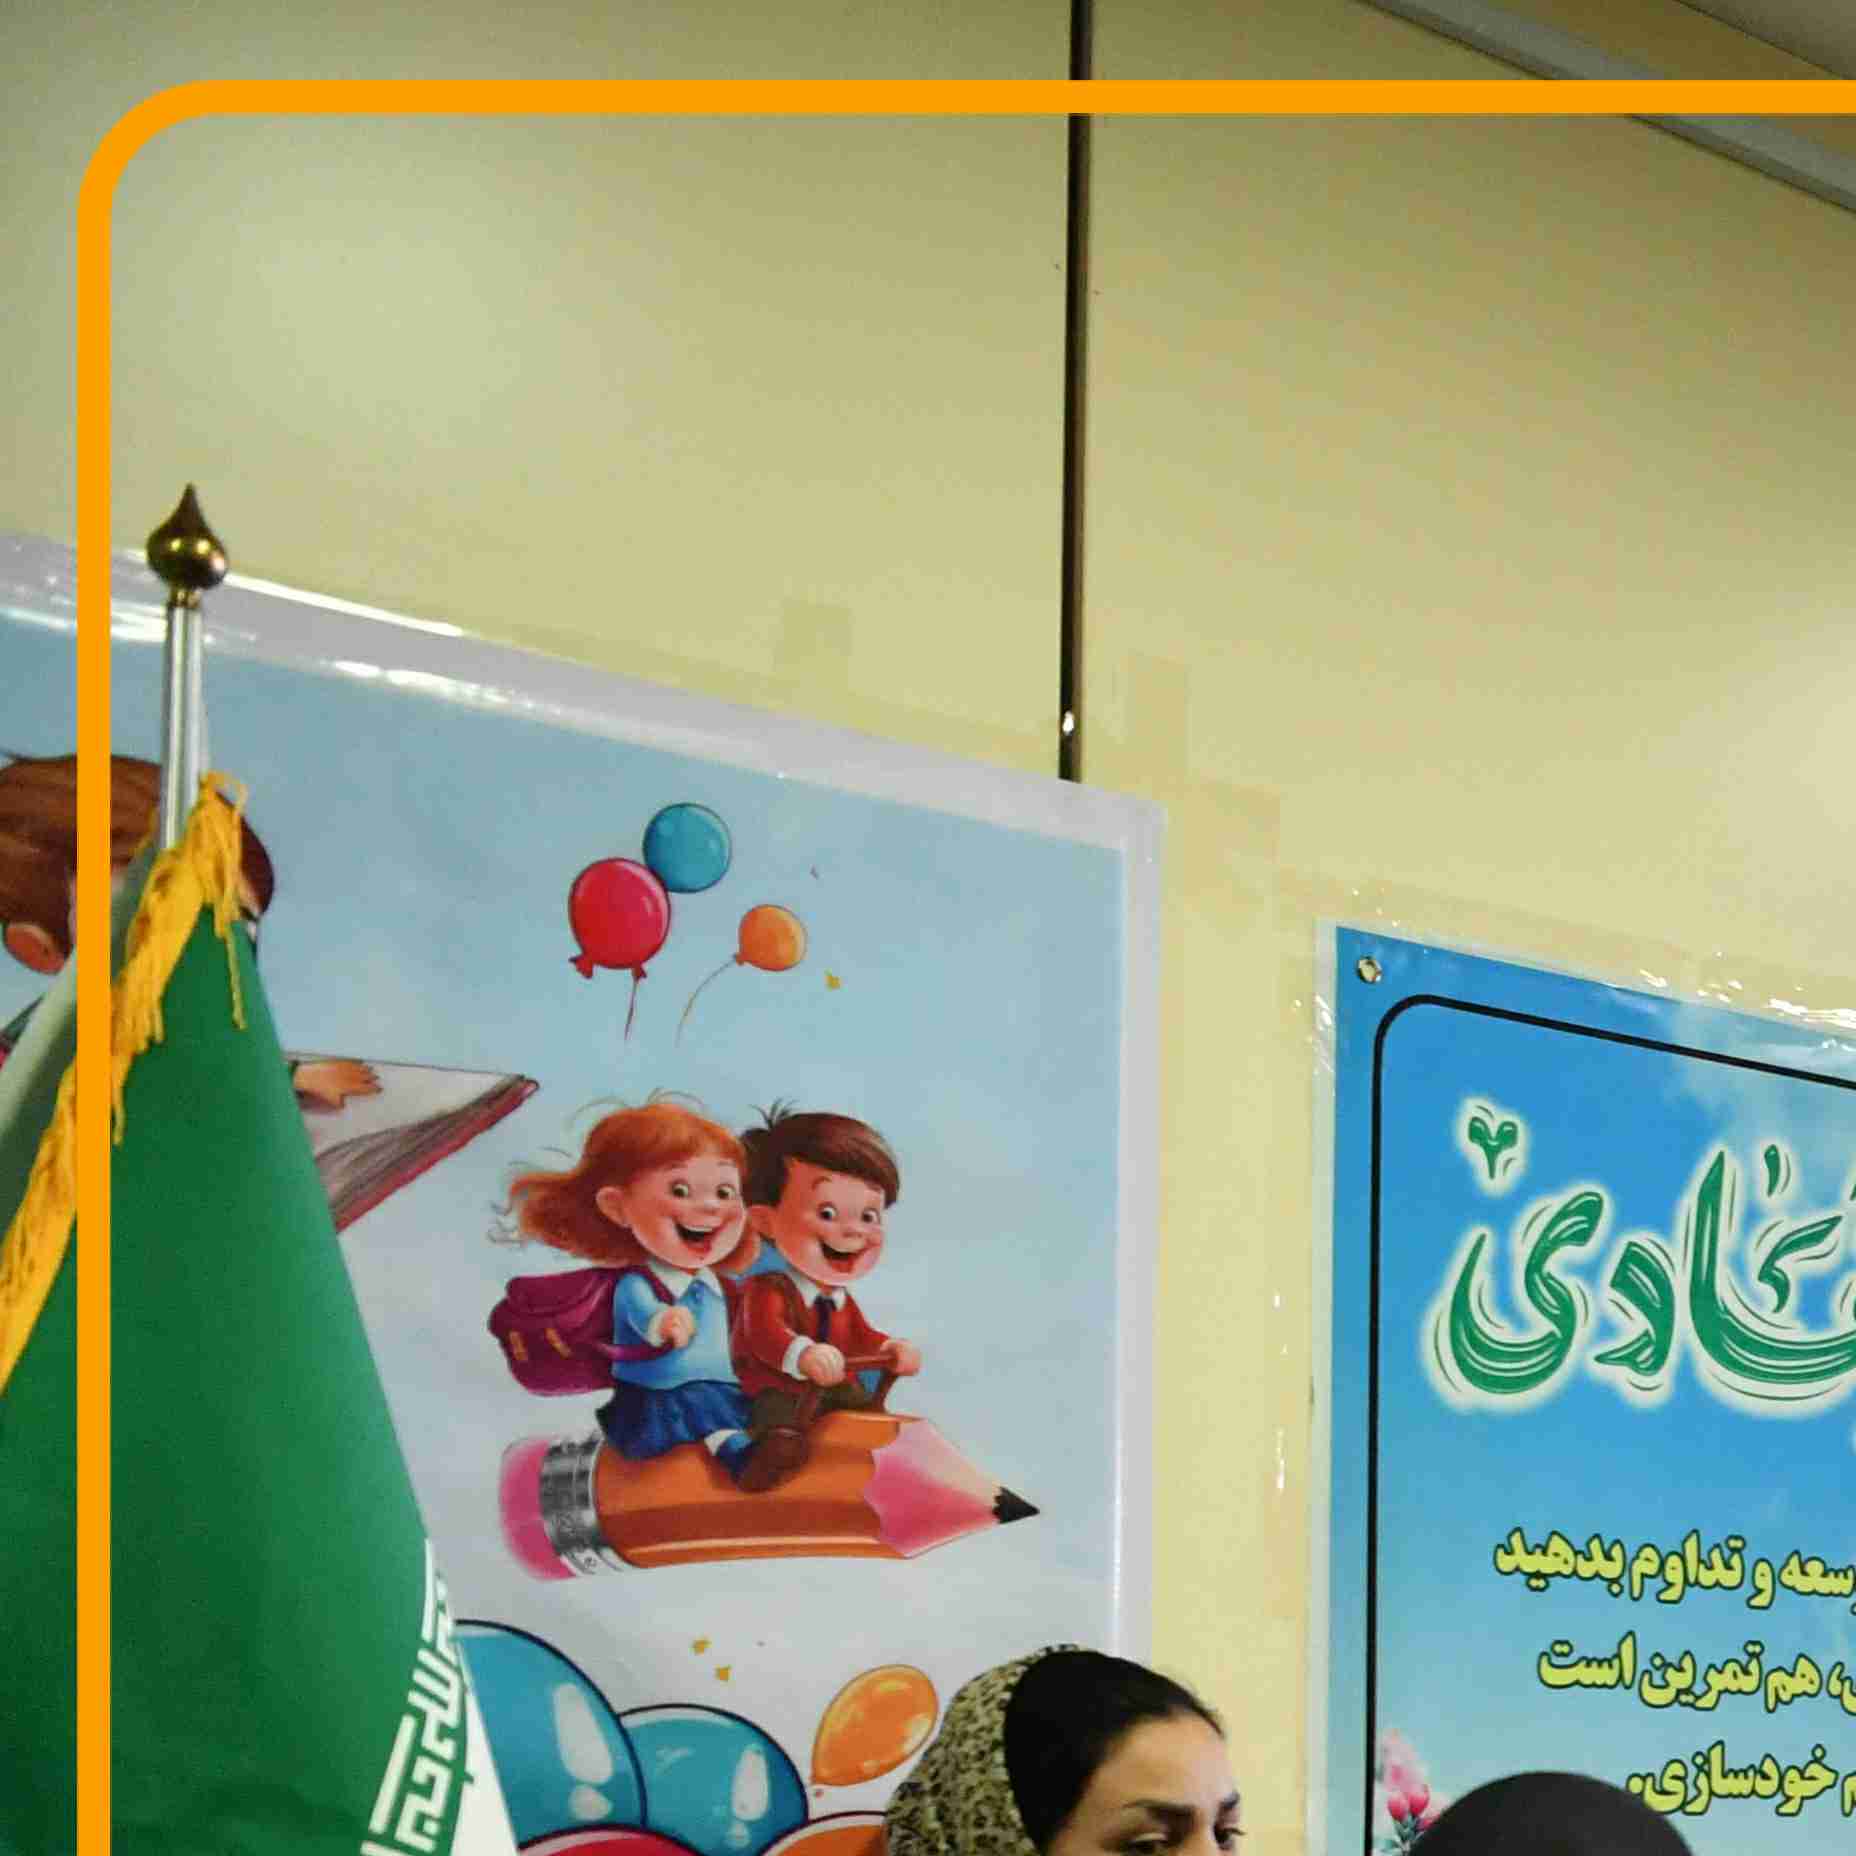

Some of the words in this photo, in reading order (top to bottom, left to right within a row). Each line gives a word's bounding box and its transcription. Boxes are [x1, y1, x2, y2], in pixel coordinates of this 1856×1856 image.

[1494, 1527, 1625, 1597] بدهید
[1630, 1529, 1746, 1603] تداوم
[1746, 1558, 1774, 1609] و
[1538, 1630, 1637, 1689] است
[1640, 1641, 1764, 1710] تمرین
[1765, 1653, 1822, 1713] هم
